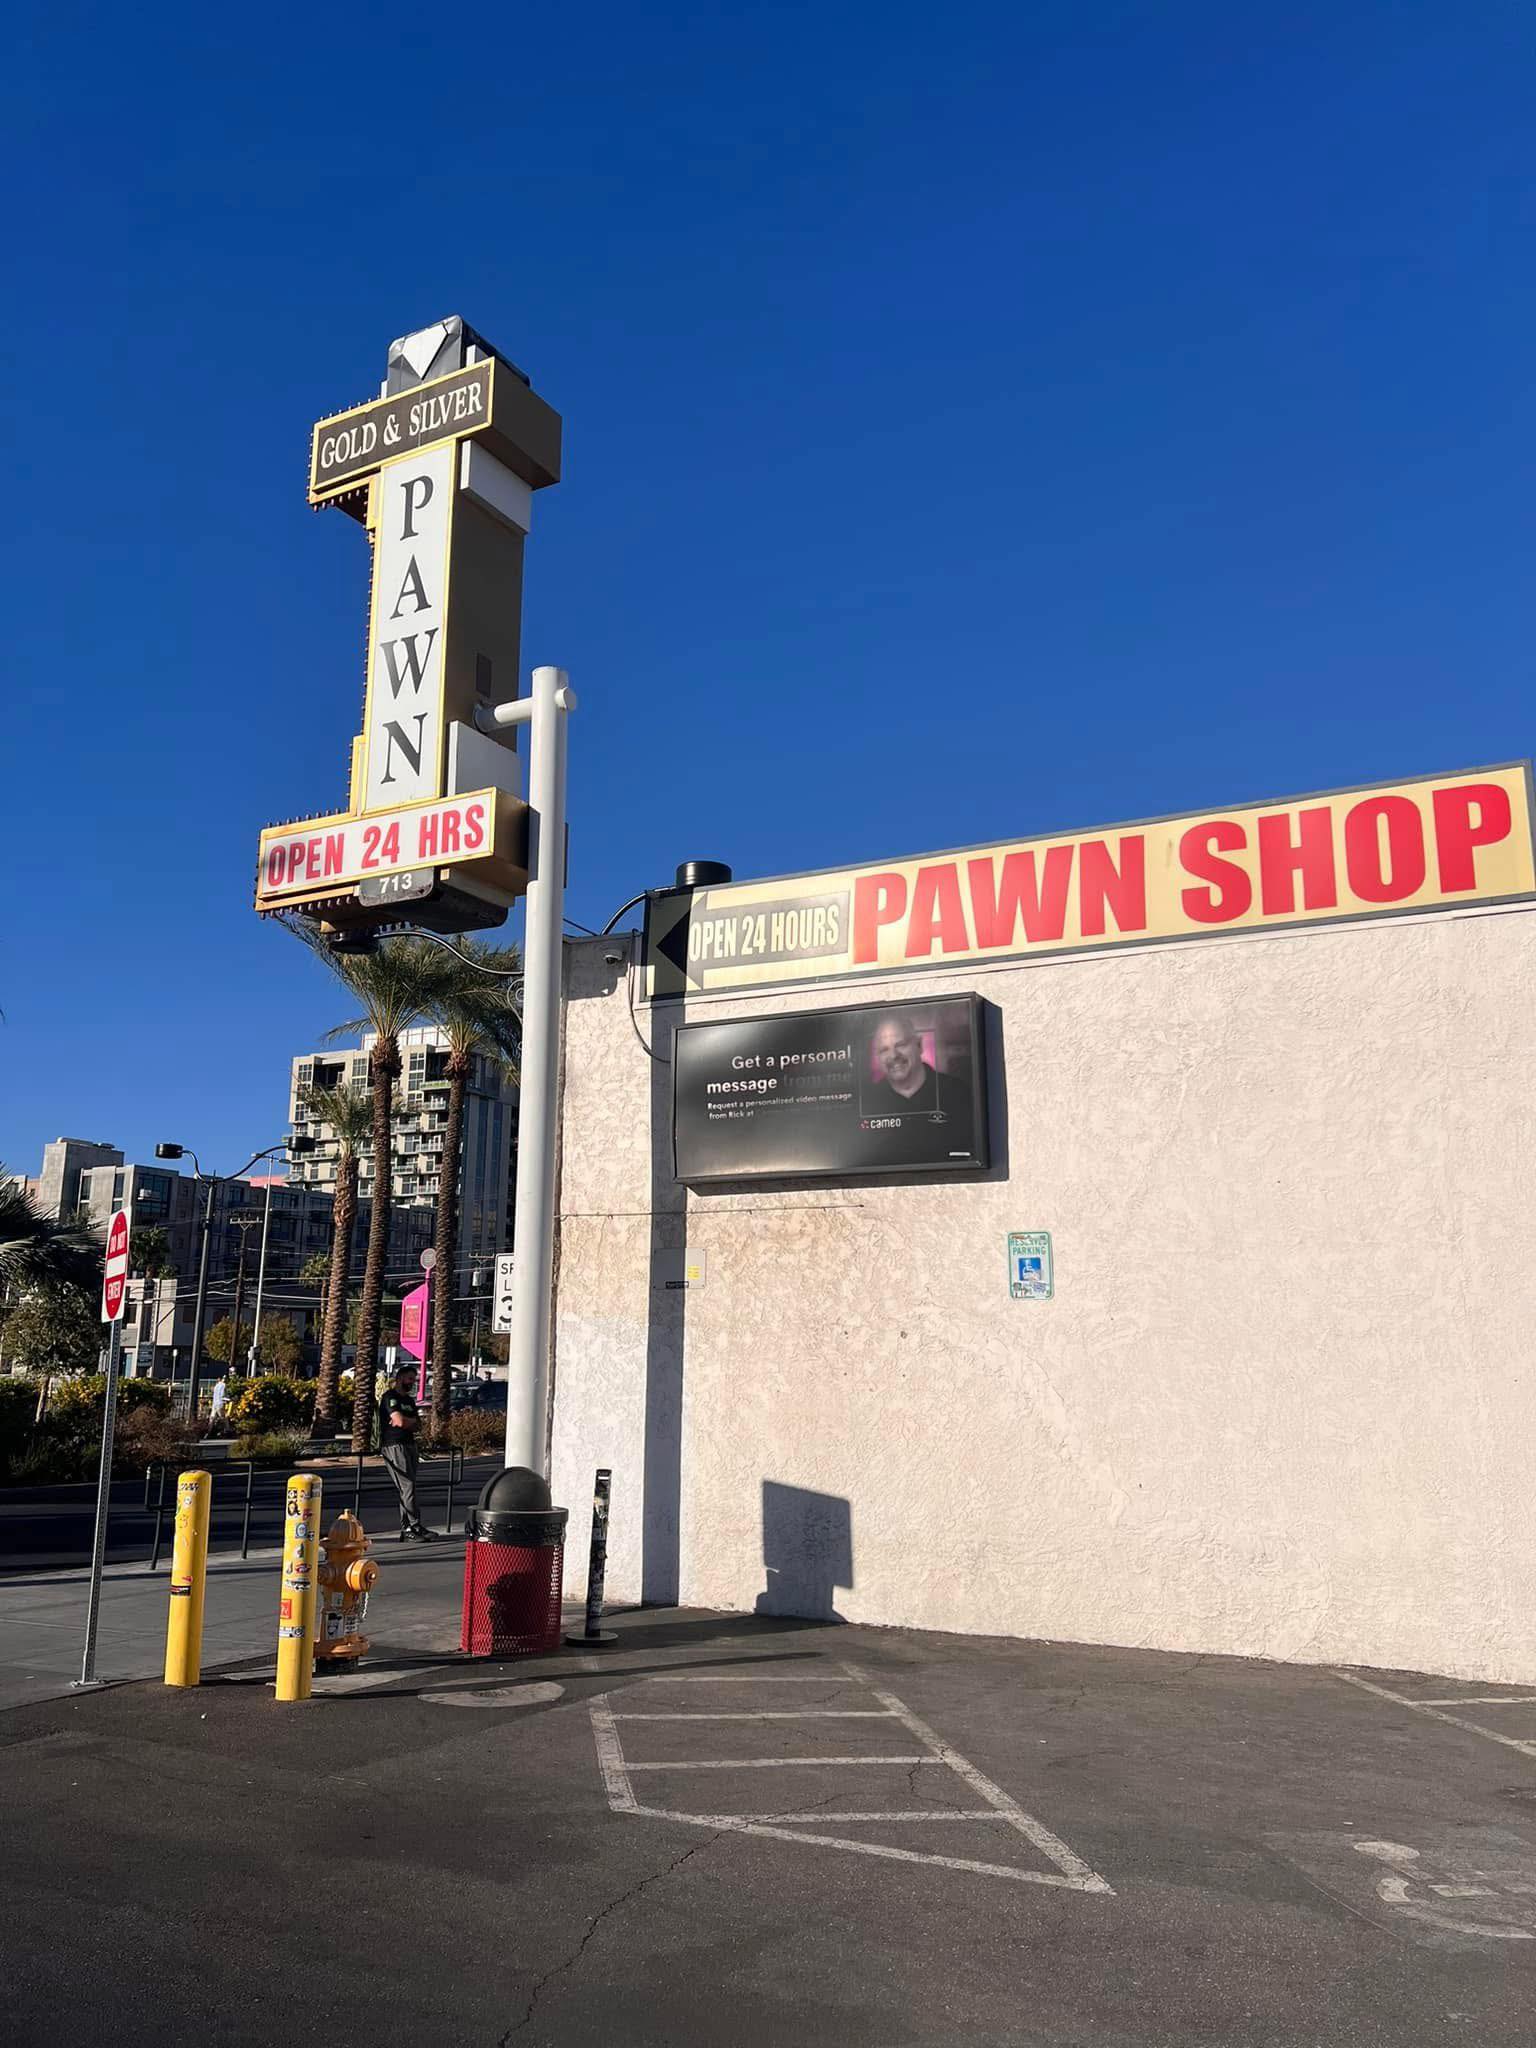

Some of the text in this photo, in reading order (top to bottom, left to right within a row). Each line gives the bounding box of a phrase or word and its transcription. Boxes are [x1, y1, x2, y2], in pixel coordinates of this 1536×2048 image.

[320, 382, 484, 469] GOLD & SILVER
[380, 475, 440, 785] PAWN
[267, 804, 485, 887] OPEN 24 HRS
[379, 873, 413, 894] 713
[853, 783, 1513, 965] PAWN SHOP
[688, 904, 841, 963] OPEN 24 HOURS
[731, 1045, 851, 1070] Get a personal
[706, 1077, 778, 1094] message
[707, 1101, 738, 1111] Request
[745, 1096, 795, 1108] personalized
[796, 1094, 818, 1104] video
[818, 1092, 853, 1103] message
[708, 1111, 728, 1121] from
[870, 1117, 902, 1129] cameo
[1012, 1246, 1047, 1256] PARKING
